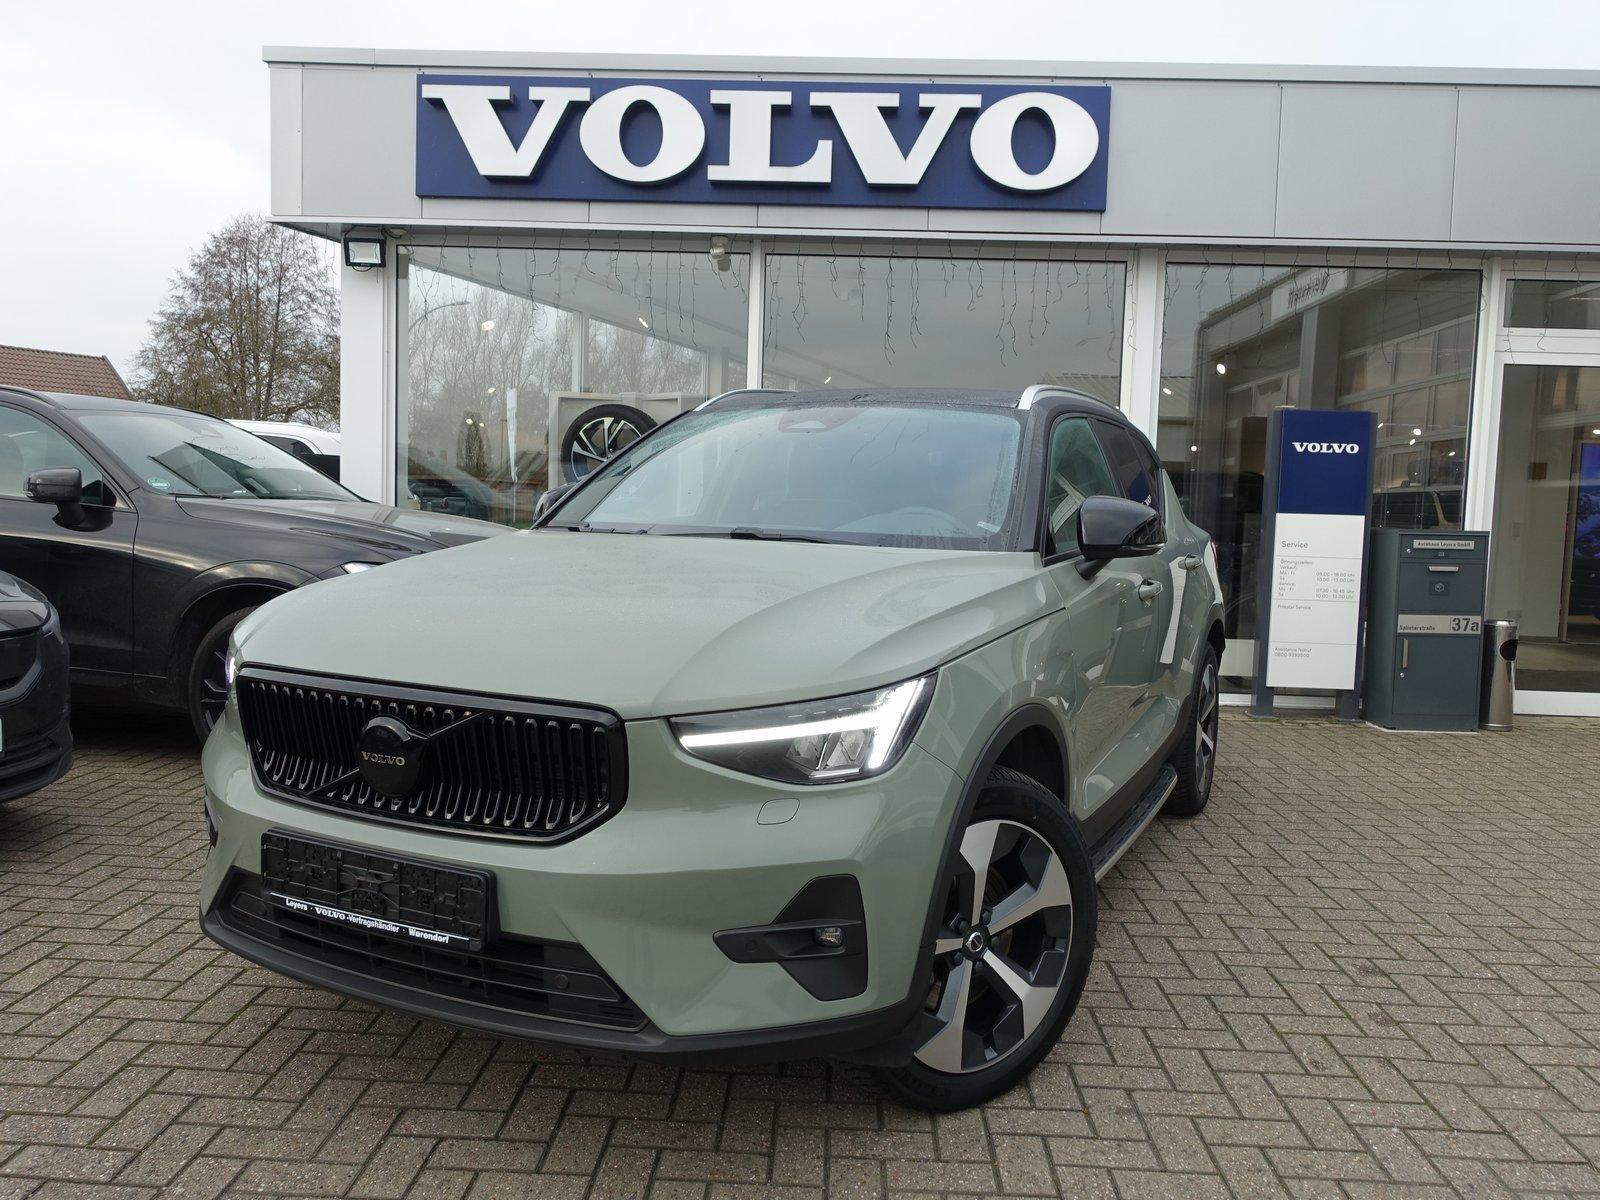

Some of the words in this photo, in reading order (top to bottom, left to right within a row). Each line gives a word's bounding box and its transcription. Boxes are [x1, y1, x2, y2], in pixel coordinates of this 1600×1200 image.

[421, 84, 1100, 192] VOLVO
[1292, 441, 1360, 454] VOLVO
[1281, 540, 1309, 549] Service
[1452, 617, 1480, 632] 37a
[361, 751, 405, 766] VOLVO
[285, 898, 308, 911] Leyers
[314, 906, 345, 920] VOLVO
[408, 927, 449, 944] Warendorf
